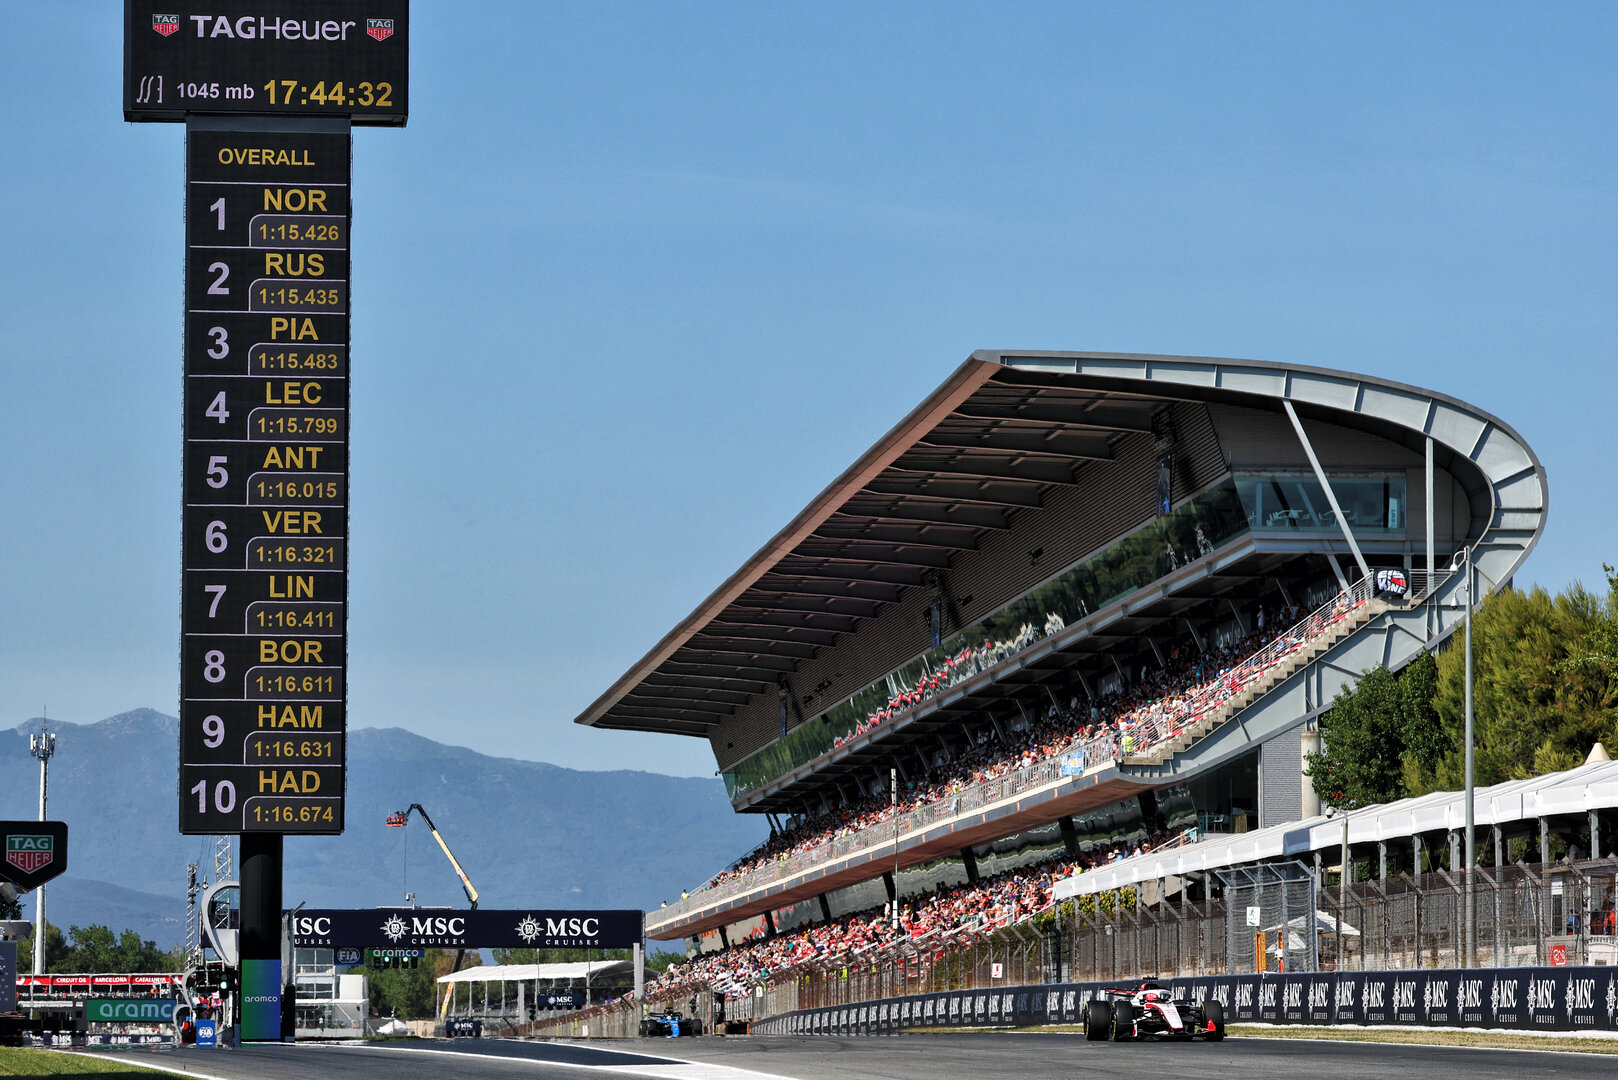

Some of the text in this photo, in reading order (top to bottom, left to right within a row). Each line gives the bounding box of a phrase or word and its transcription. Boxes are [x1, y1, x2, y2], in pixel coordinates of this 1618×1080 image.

[154, 24, 178, 33] HEUER
[156, 15, 177, 23] TAG
[370, 20, 391, 28] TAG
[368, 29, 392, 38] HEUER
[177, 83, 254, 99] 1045 mb
[264, 80, 392, 106] 17:44:32
[219, 148, 315, 165] OVERALL
[264, 189, 327, 211] NOR
[211, 198, 225, 230] 1
[260, 224, 338, 240] 1:15.426
[266, 253, 324, 276] RUS
[208, 262, 229, 294] 2
[260, 289, 338, 304] 1:15.435
[272, 318, 318, 340] PIA
[208, 327, 229, 359] 3
[259, 353, 337, 368] 1:15.483
[266, 382, 321, 404] LEC
[206, 392, 229, 423] 4
[258, 418, 336, 433] 1:15.799
[263, 447, 322, 468] ANT
[207, 456, 228, 488] 5
[258, 482, 336, 497] 1:16.015
[263, 511, 322, 533] VER
[206, 521, 227, 553] 6
[257, 547, 333, 562] 1:16.321
[270, 576, 313, 597] LIN
[205, 585, 226, 617] 7
[257, 611, 332, 627] 1:16.411
[260, 640, 323, 663] BOR
[204, 650, 225, 682] 8
[256, 676, 331, 692] 1:16.611
[259, 705, 322, 727] HAM
[203, 715, 224, 748] 9
[255, 741, 330, 756] 1:16.631
[260, 771, 320, 792] HAD
[192, 780, 236, 813] 10
[254, 806, 333, 821] 1:16.674
[11, 837, 50, 850] TAG
[8, 851, 52, 872] HEUER
[294, 918, 330, 935] SC
[412, 918, 464, 935] MSC
[546, 918, 598, 936] MSC
[373, 949, 419, 957] aramco
[244, 995, 278, 1003] aramco
[1314, 982, 1329, 1007] MSC
[1340, 981, 1355, 1006] MSC
[1369, 981, 1385, 1007] MSC
[1400, 981, 1417, 1007] MSC
[1432, 980, 1449, 1008] MSC
[1465, 980, 1483, 1008] MSC
[1500, 979, 1518, 1008] MSC
[1536, 979, 1556, 1009] MSC
[1575, 978, 1596, 1009] MSC
[100, 1003, 173, 1018] aramc
[199, 1027, 213, 1037] FIA
